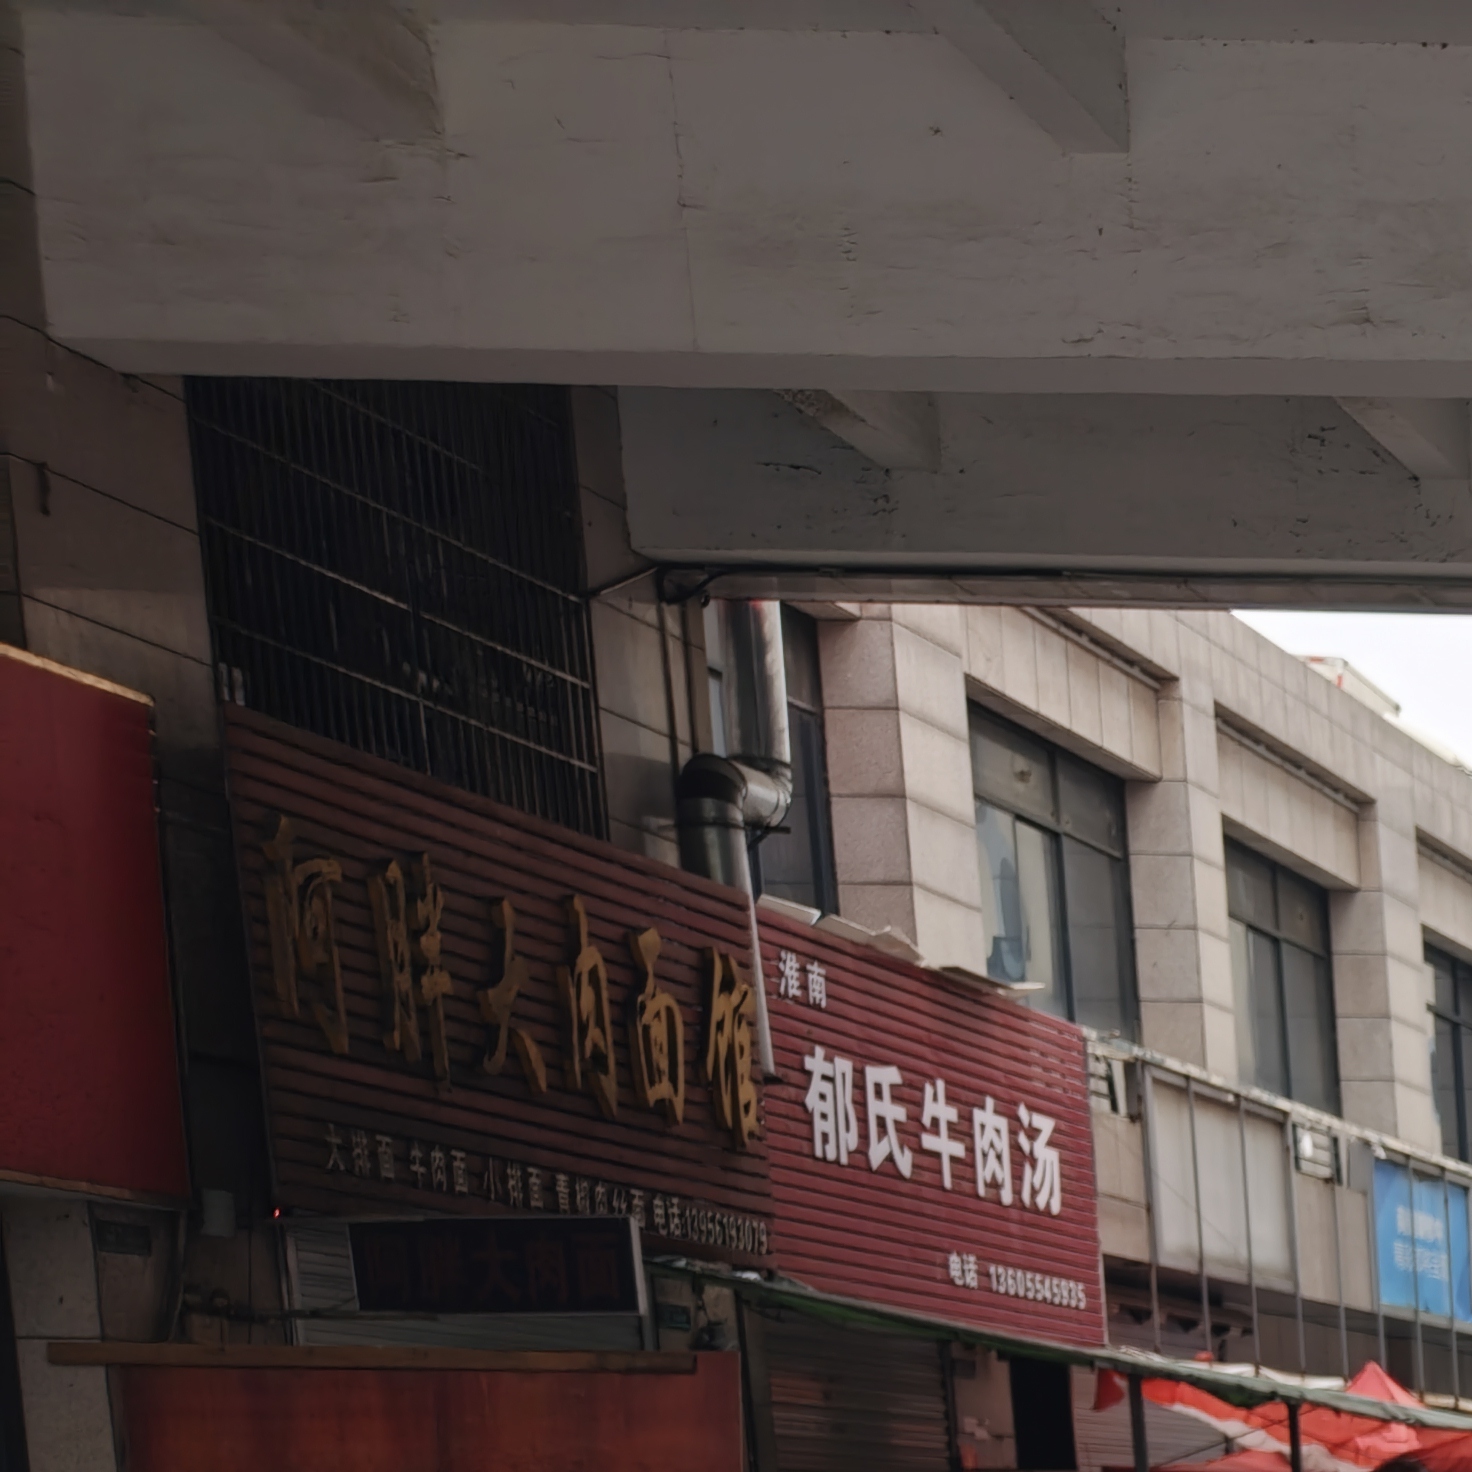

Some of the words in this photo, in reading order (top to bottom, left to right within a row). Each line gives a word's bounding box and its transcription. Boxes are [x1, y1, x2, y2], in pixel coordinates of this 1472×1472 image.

[778, 950, 827, 1009] 淮南
[804, 1044, 1062, 1215] 郁氏牛肉汤
[409, 1141, 469, 1194] 牛肉面
[948, 1250, 979, 1290] 电话
